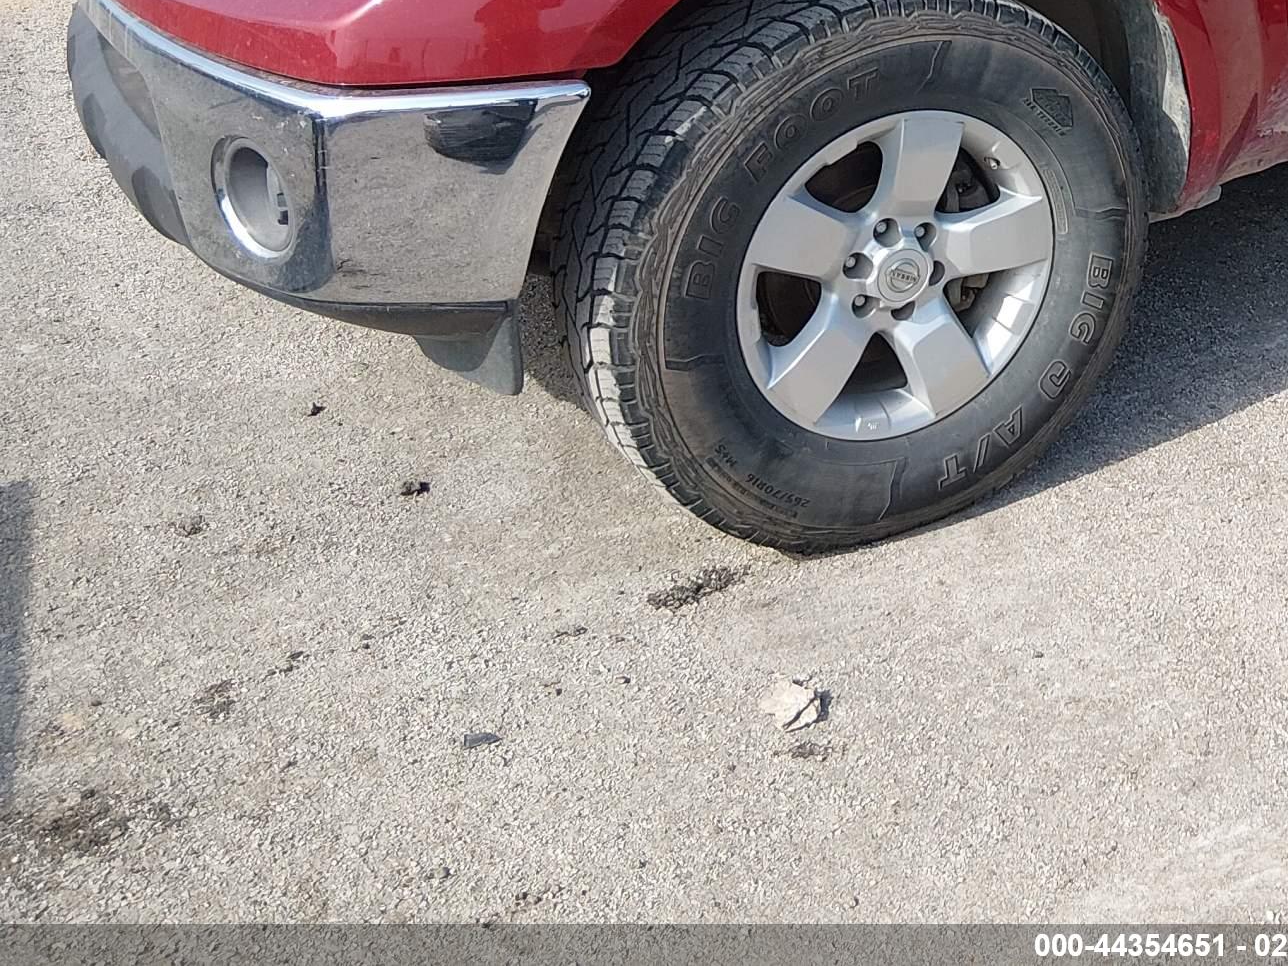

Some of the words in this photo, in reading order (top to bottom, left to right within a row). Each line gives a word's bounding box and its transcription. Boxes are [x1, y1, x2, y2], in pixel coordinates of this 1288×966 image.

[684, 195, 742, 299] BIG
[743, 67, 879, 183] FOOT
[1069, 251, 1115, 345] BIG
[937, 405, 1024, 490] A/T
